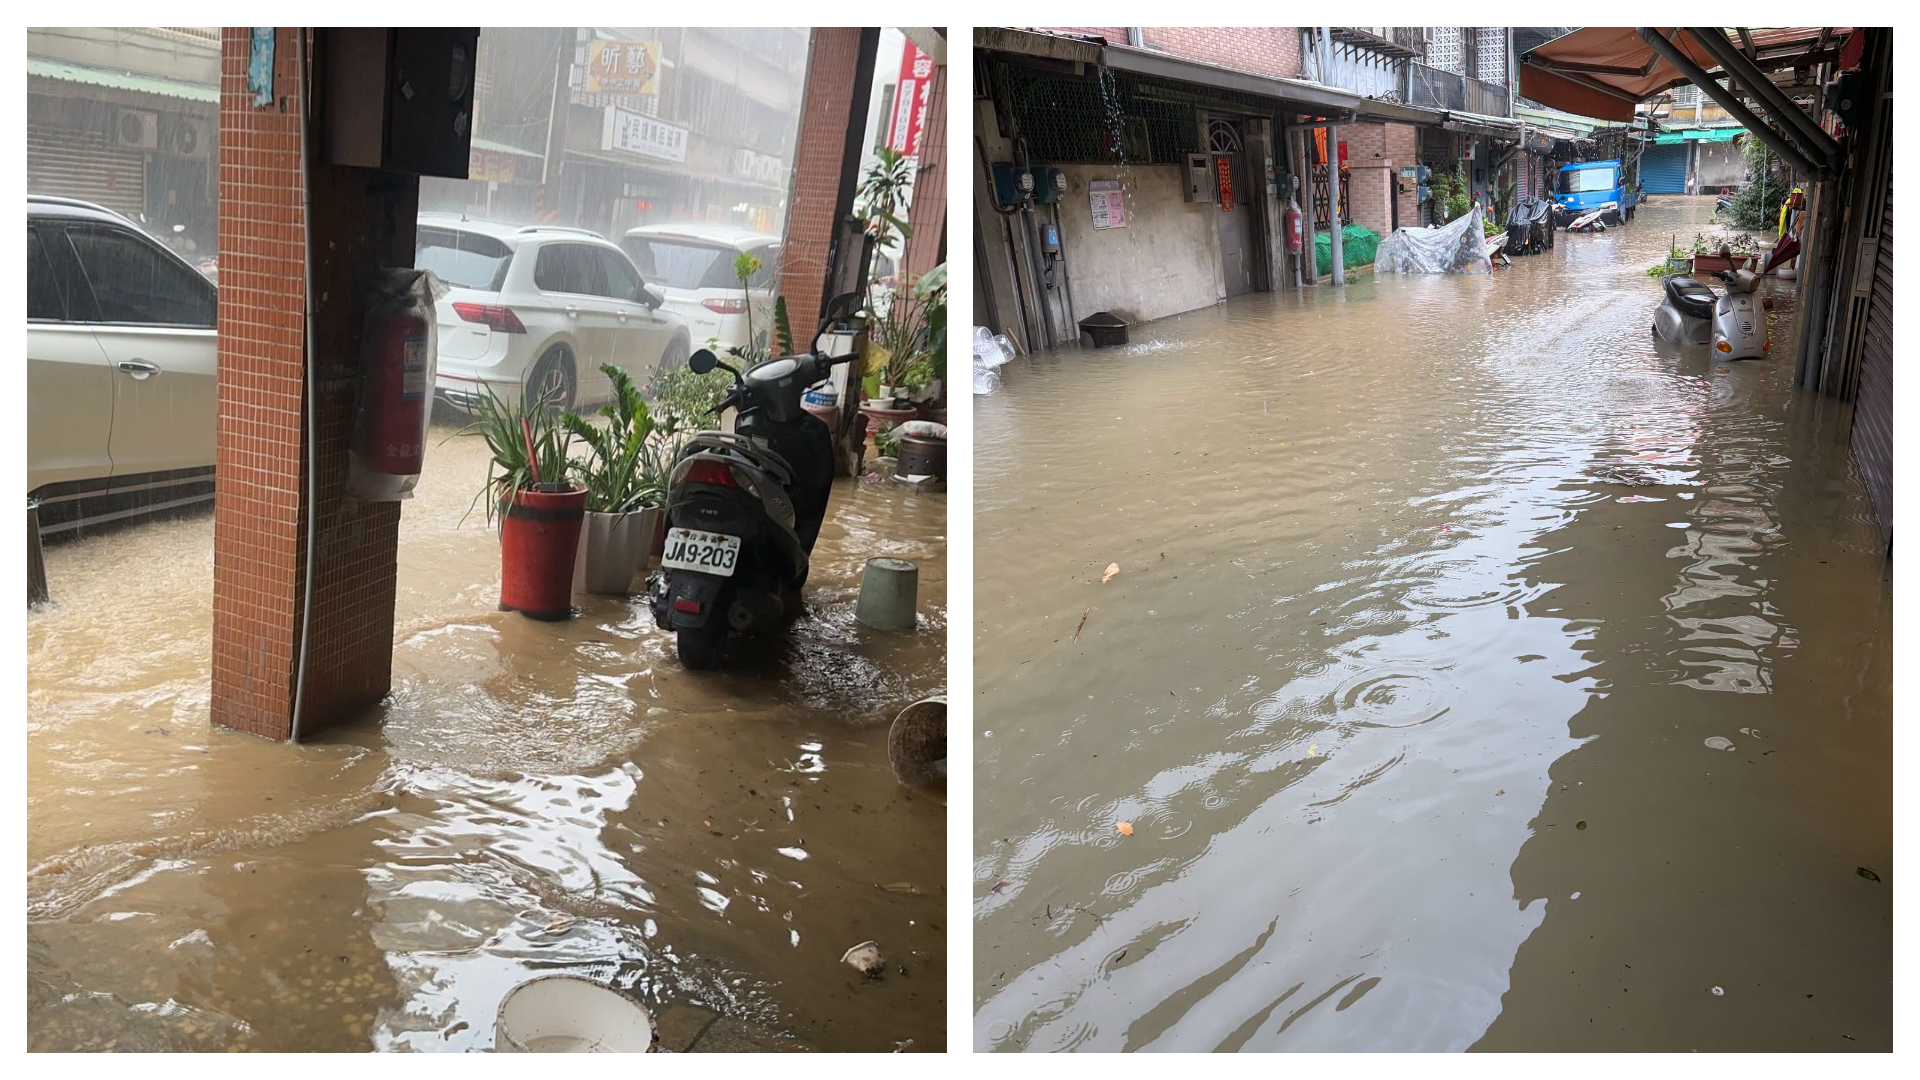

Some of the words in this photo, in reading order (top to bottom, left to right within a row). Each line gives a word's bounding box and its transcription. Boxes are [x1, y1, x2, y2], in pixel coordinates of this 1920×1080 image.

[602, 45, 645, 74] 昕藝
[689, 532, 717, 544] 台灣省
[665, 541, 736, 569] JA9-203
